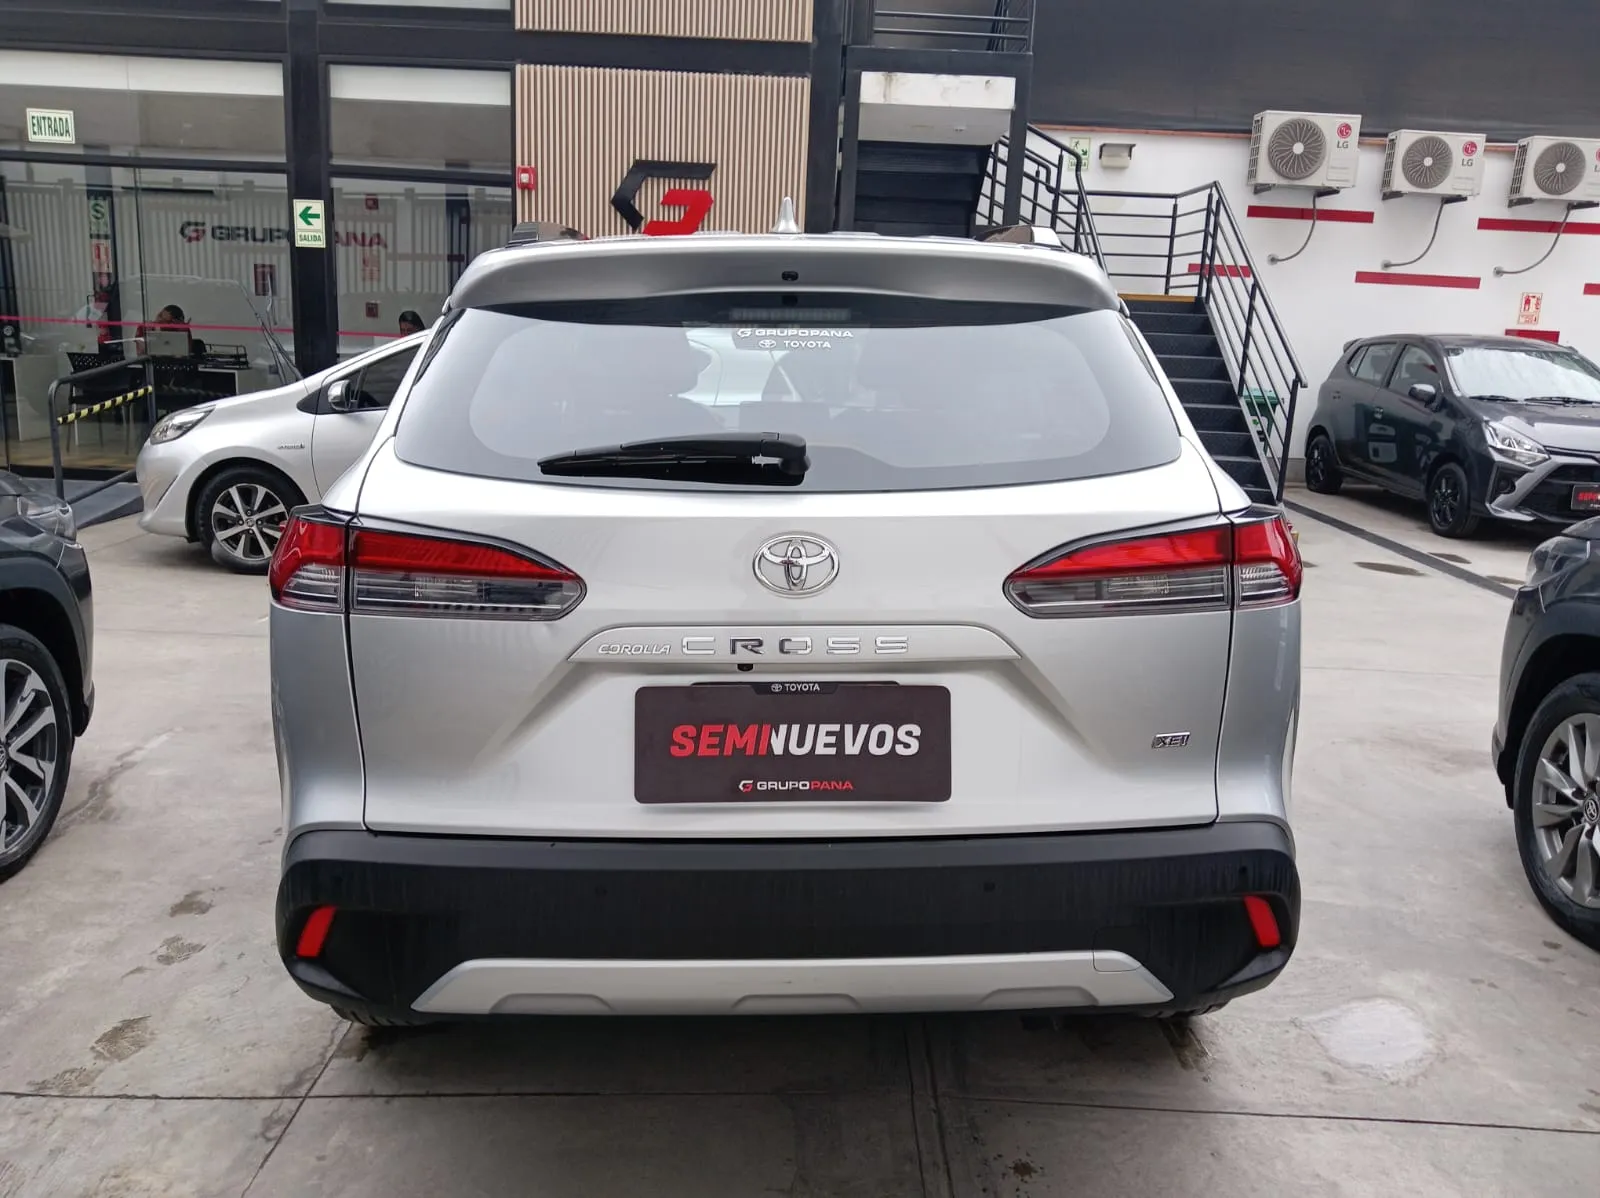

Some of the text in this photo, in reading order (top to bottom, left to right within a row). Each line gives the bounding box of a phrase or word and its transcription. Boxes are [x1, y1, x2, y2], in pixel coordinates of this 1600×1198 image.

[31, 115, 71, 137] ENTRADA
[1336, 140, 1349, 149] LG
[1461, 158, 1474, 167] LG
[211, 224, 388, 249] GRUPANA
[299, 234, 322, 243] SALIDA
[755, 329, 853, 338] GRUPOPANA
[783, 340, 831, 349] TOYOTA
[598, 636, 909, 655] COROLLA CROSS
[784, 683, 820, 692] TOYOTA
[670, 724, 922, 757] SEMINUEVOS
[757, 780, 853, 791] GRUPOPANA
